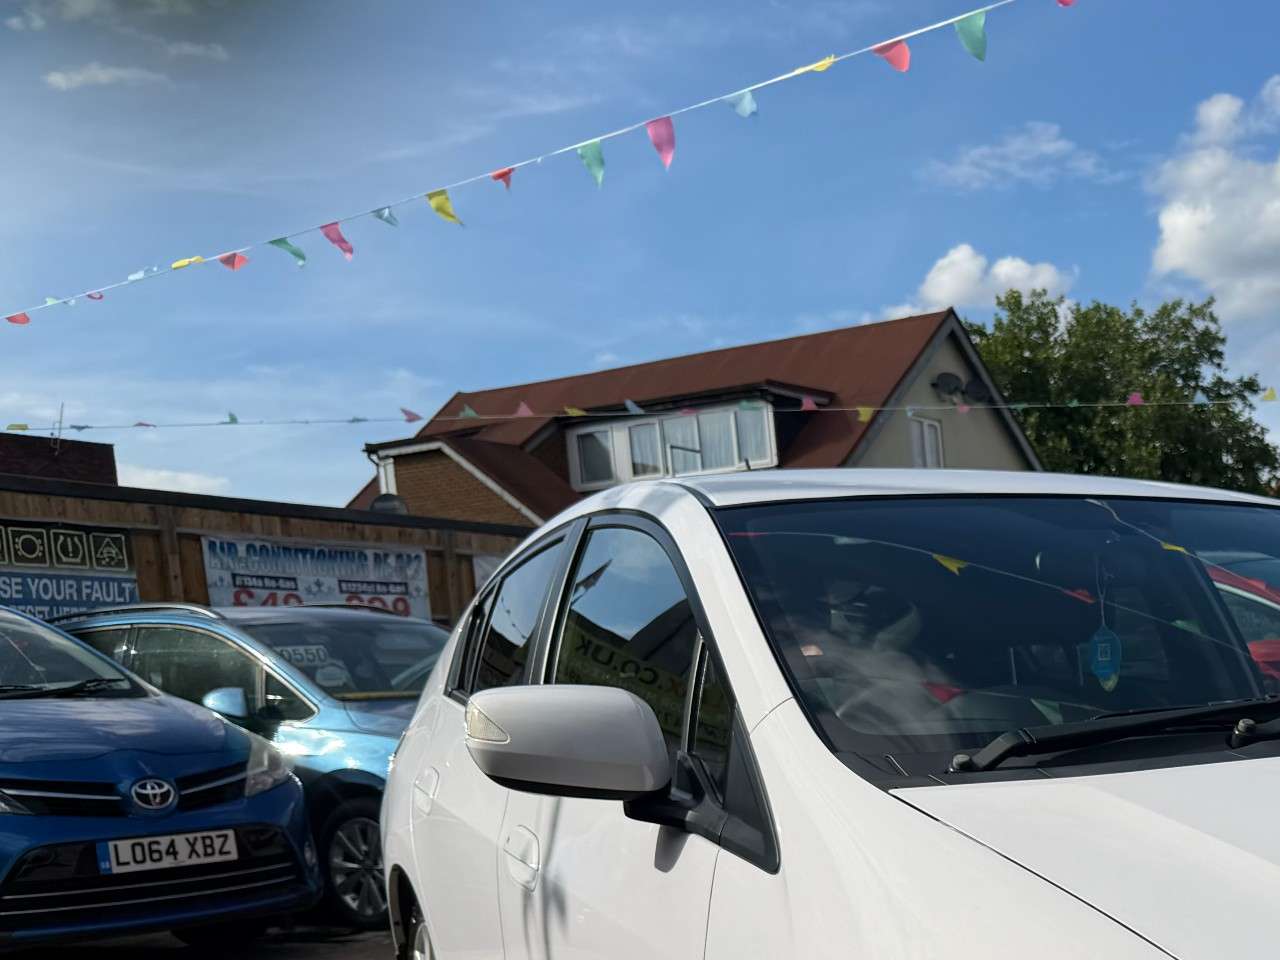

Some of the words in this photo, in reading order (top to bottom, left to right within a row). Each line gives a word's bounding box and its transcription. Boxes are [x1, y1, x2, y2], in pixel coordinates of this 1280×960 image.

[27, 578, 79, 600] YOUR
[82, 581, 133, 602] FAULT
[113, 838, 179, 867] LO64
[185, 833, 232, 859] XBZ
